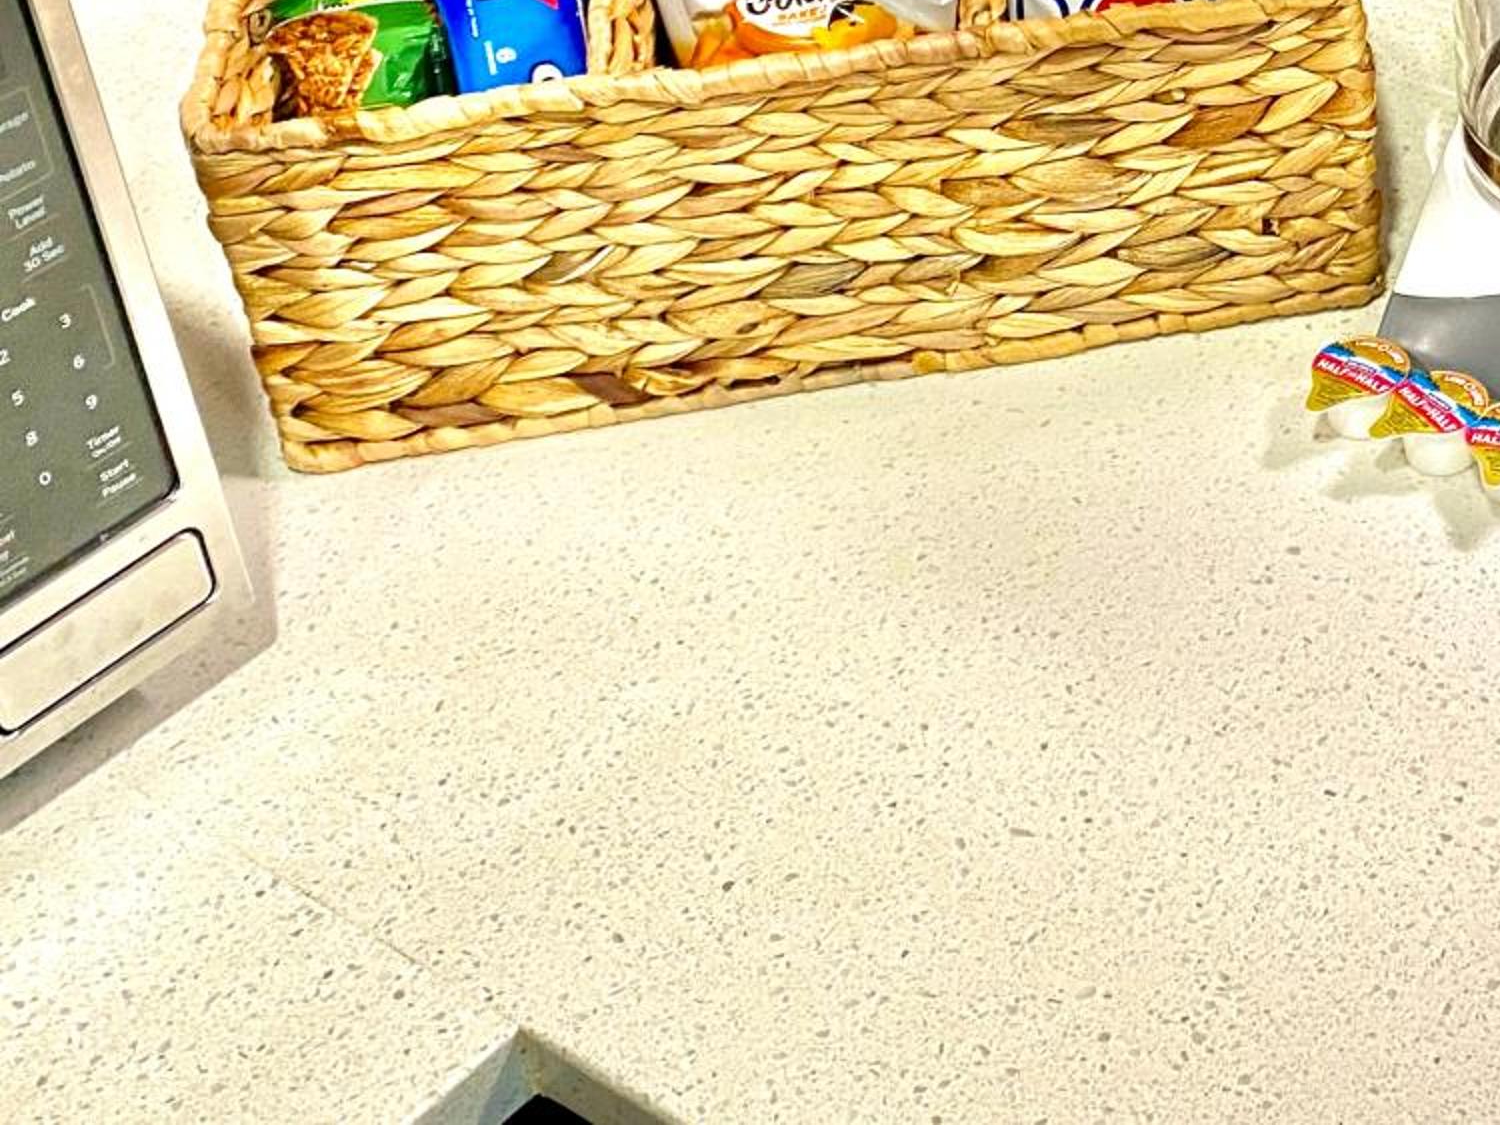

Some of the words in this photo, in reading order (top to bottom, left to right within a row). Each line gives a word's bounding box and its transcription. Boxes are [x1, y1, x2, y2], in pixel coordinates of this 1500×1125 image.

[1, 297, 36, 323] Cook
[58, 313, 72, 329] 3
[0, 349, 11, 366] 2
[73, 354, 86, 370] 6
[11, 389, 25, 407] 5
[85, 394, 98, 410] 9
[25, 430, 38, 447] 8
[39, 471, 51, 486] 0
